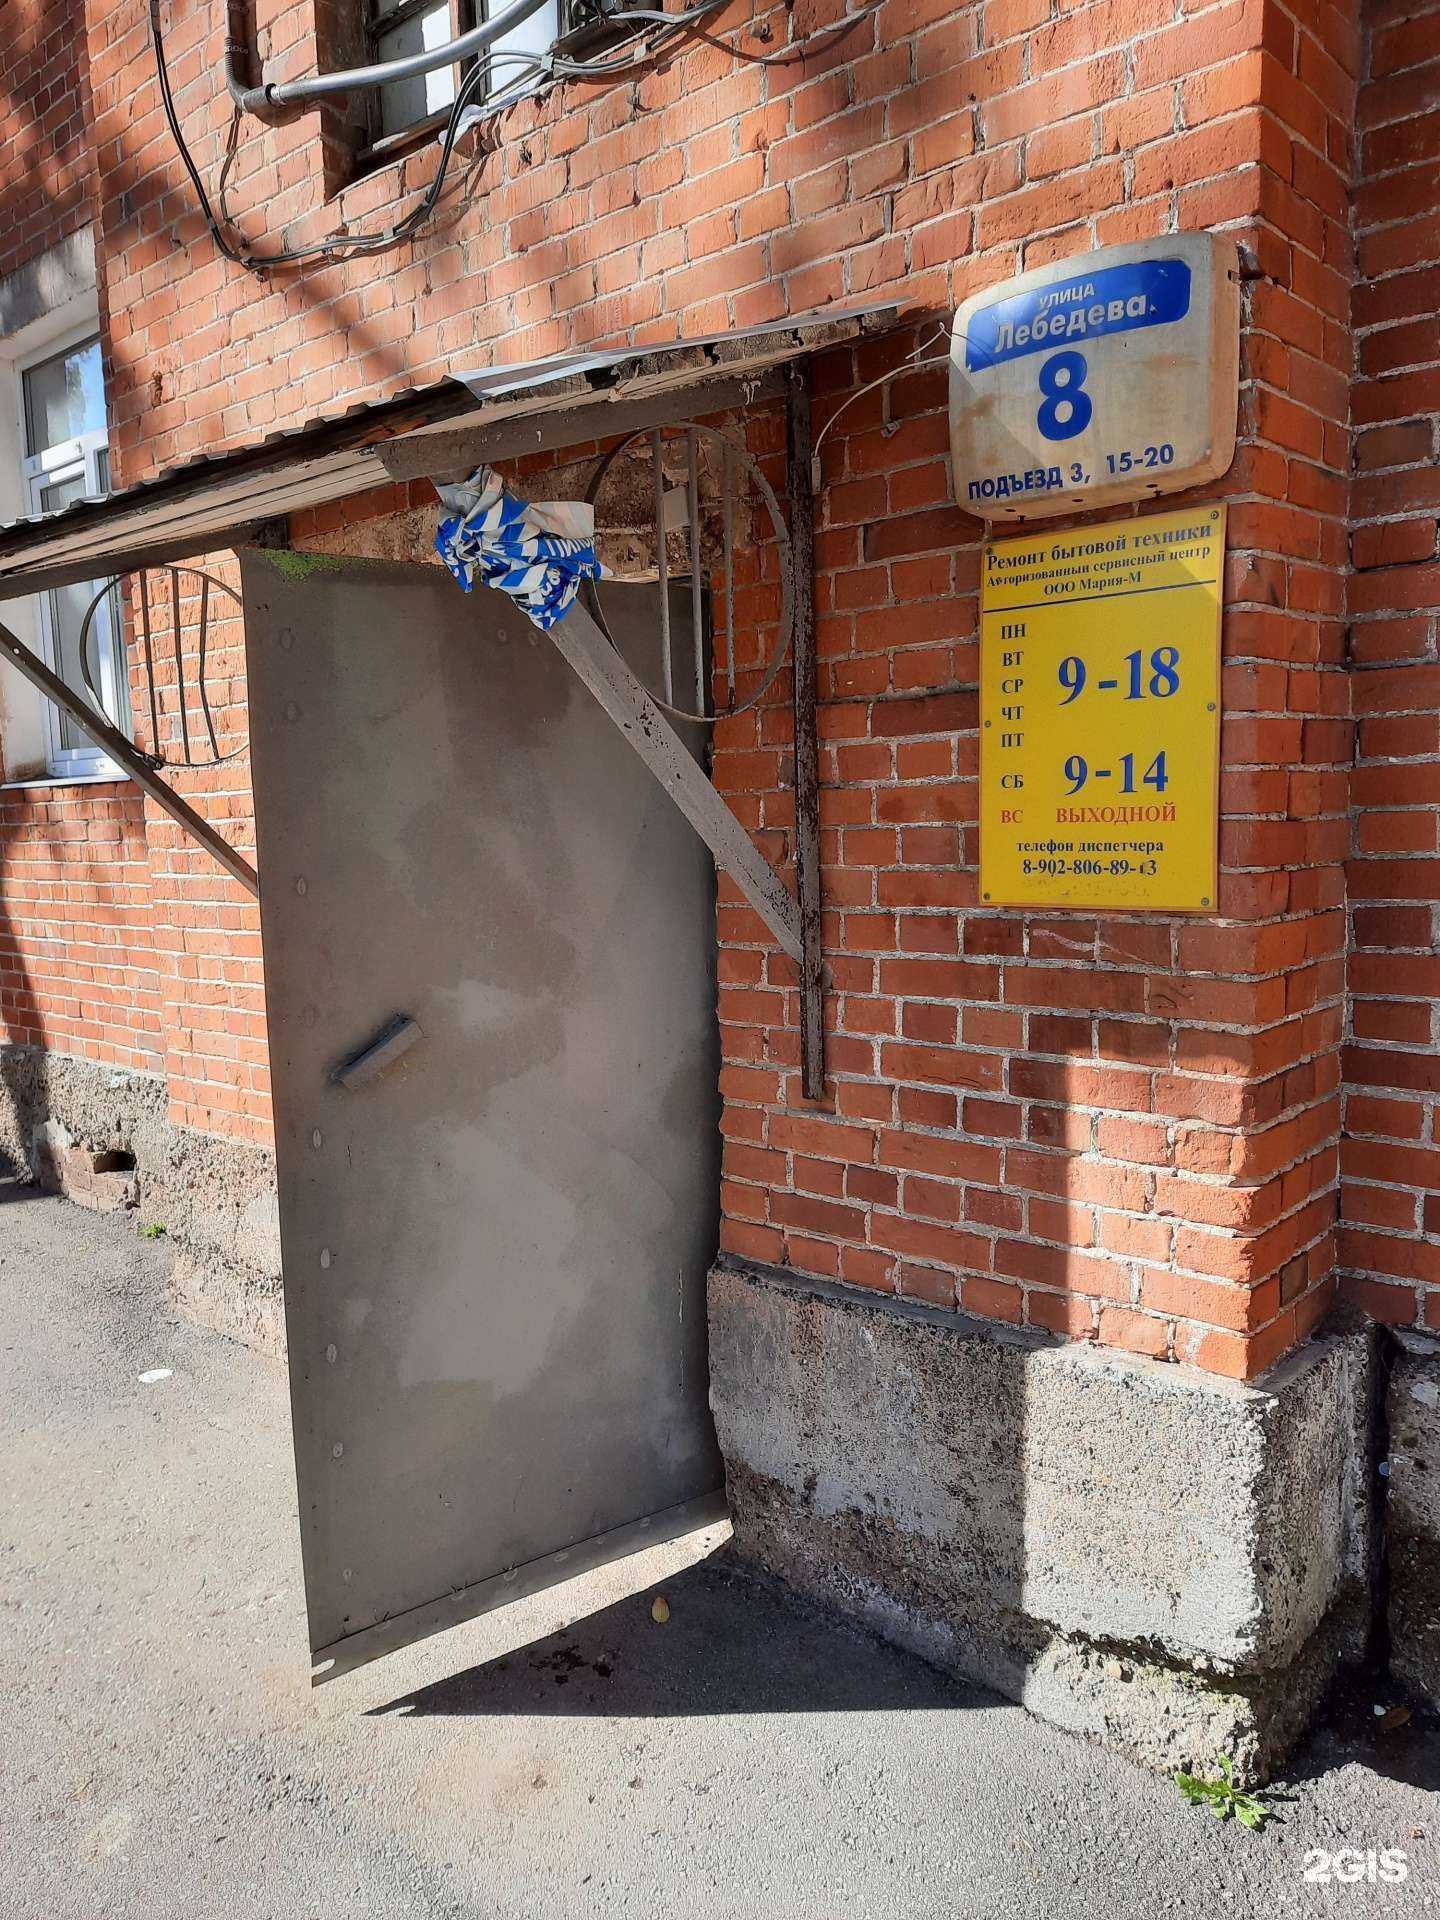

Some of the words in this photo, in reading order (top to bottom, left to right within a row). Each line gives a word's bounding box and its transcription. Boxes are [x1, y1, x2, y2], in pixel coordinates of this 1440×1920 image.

[1037, 350, 1092, 441] 8
[968, 466, 1063, 499] ПОДЪЕЗД
[1070, 462, 1091, 484] 3,
[1107, 443, 1174, 474] 15-20
[987, 551, 1047, 571] Ремонт
[1051, 535, 1126, 561] бытовой
[1132, 525, 1211, 548] техники
[1093, 551, 1165, 573] сервисный
[1169, 546, 1210, 564] центр
[1044, 581, 1075, 596] ООО
[1079, 570, 1142, 592] Мария-М
[1000, 623, 1026, 640] ПН
[1002, 651, 1024, 667] ВТ
[1001, 679, 1024, 694] СР
[1001, 706, 1024, 721] ЧТ
[1001, 733, 1024, 748] ПТ
[1001, 774, 1024, 789] СБ
[1064, 751, 1169, 795] 9-14
[1001, 810, 1023, 823] ВС
[1056, 802, 1176, 825] ВЫХОДНОЙ
[1016, 840, 1074, 854] телефон
[1078, 840, 1164, 855] диспетчера
